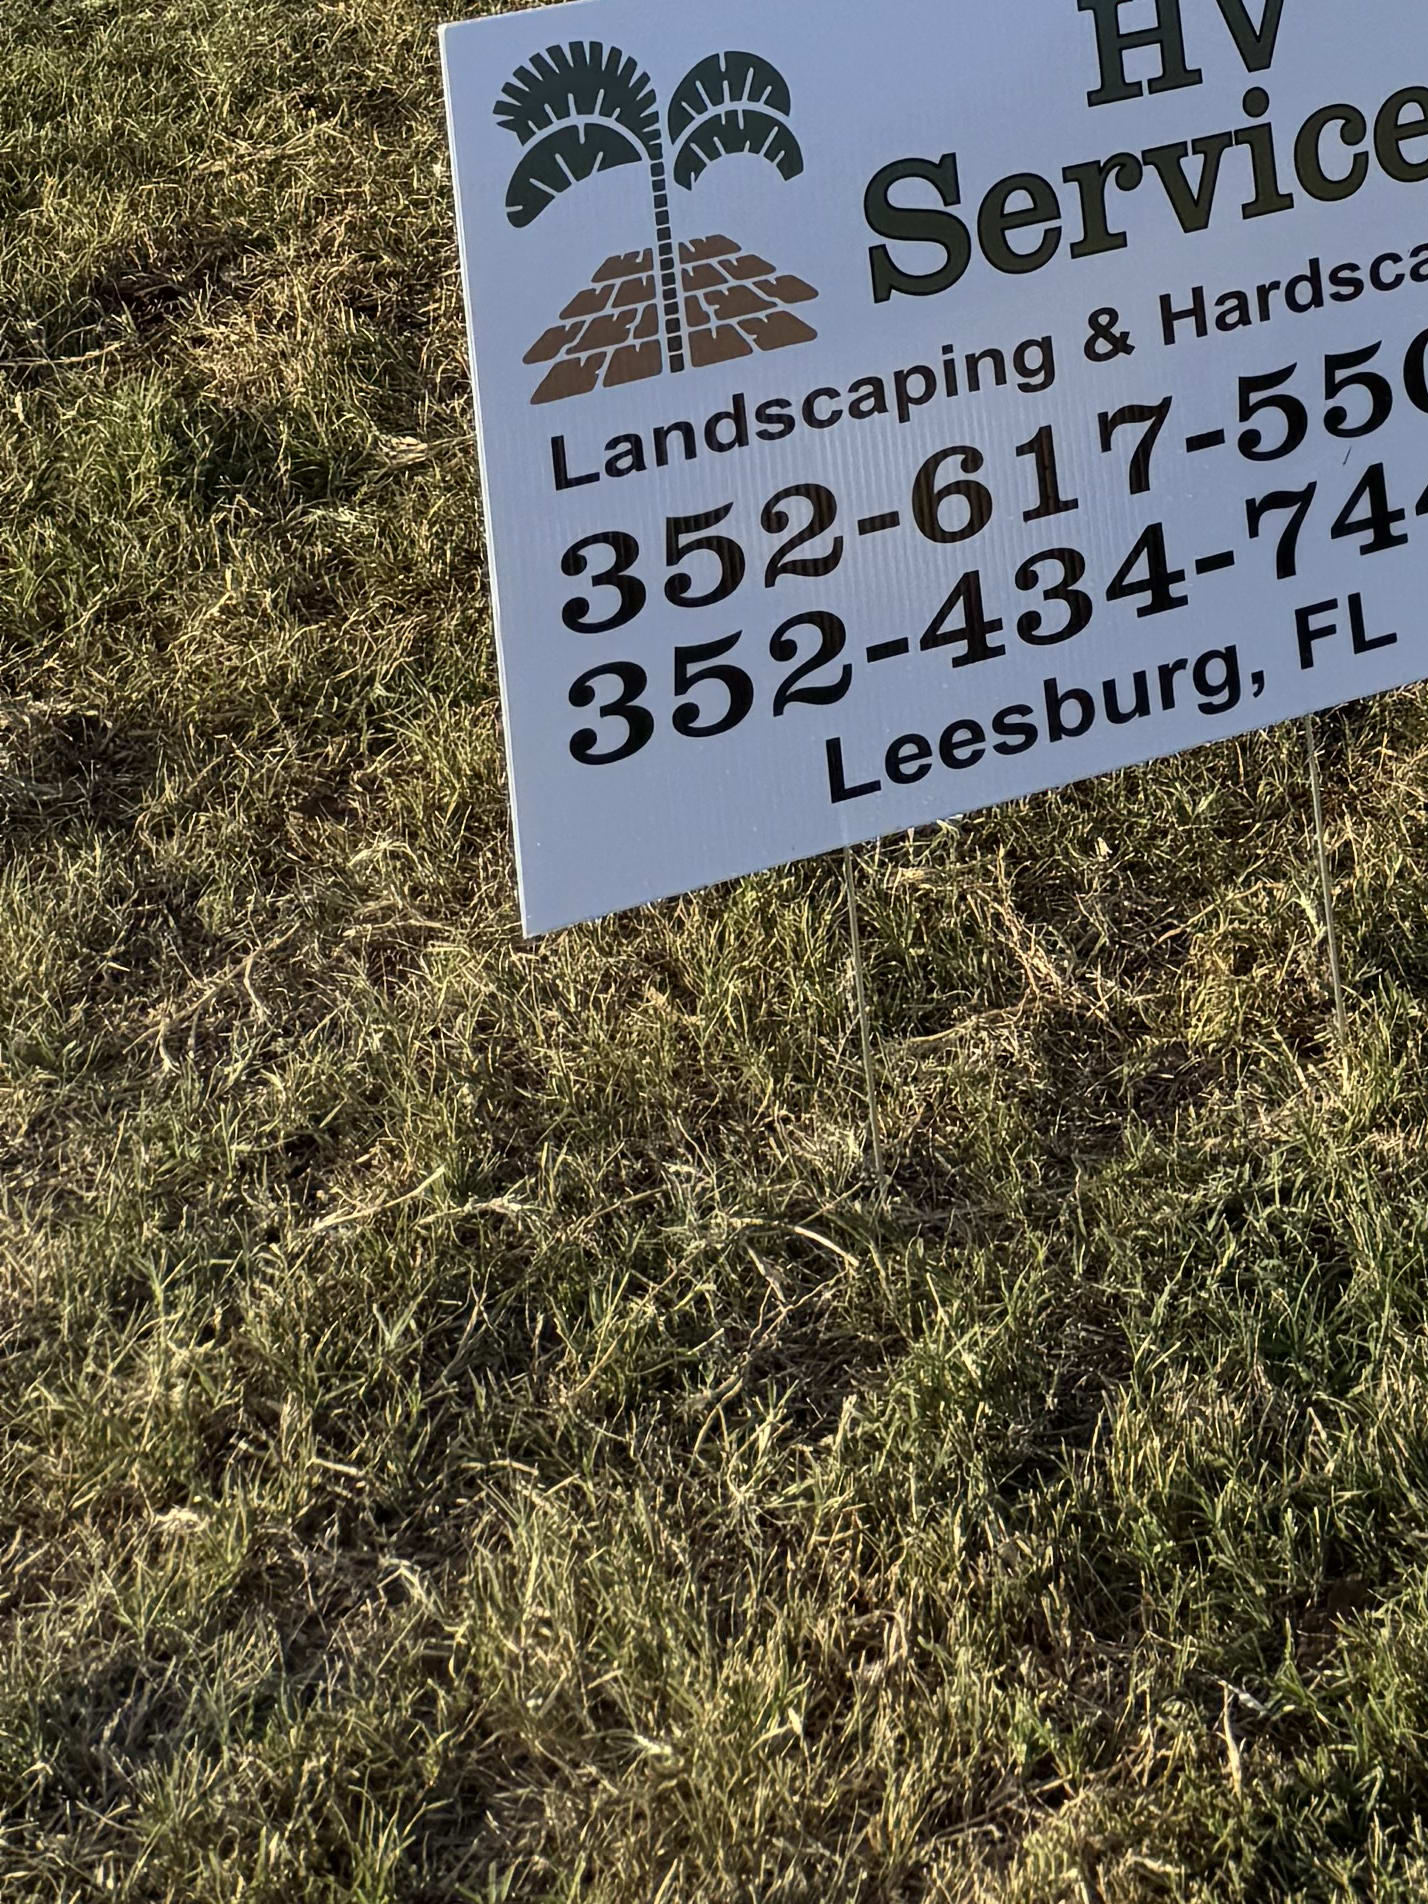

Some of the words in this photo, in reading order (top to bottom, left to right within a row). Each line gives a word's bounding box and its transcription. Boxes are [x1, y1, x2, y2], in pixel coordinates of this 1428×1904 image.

[549, 330, 1057, 493] Landscaping
[1082, 305, 1137, 364] &
[824, 640, 1267, 806] Leesburg,
[1293, 590, 1399, 672] FL
